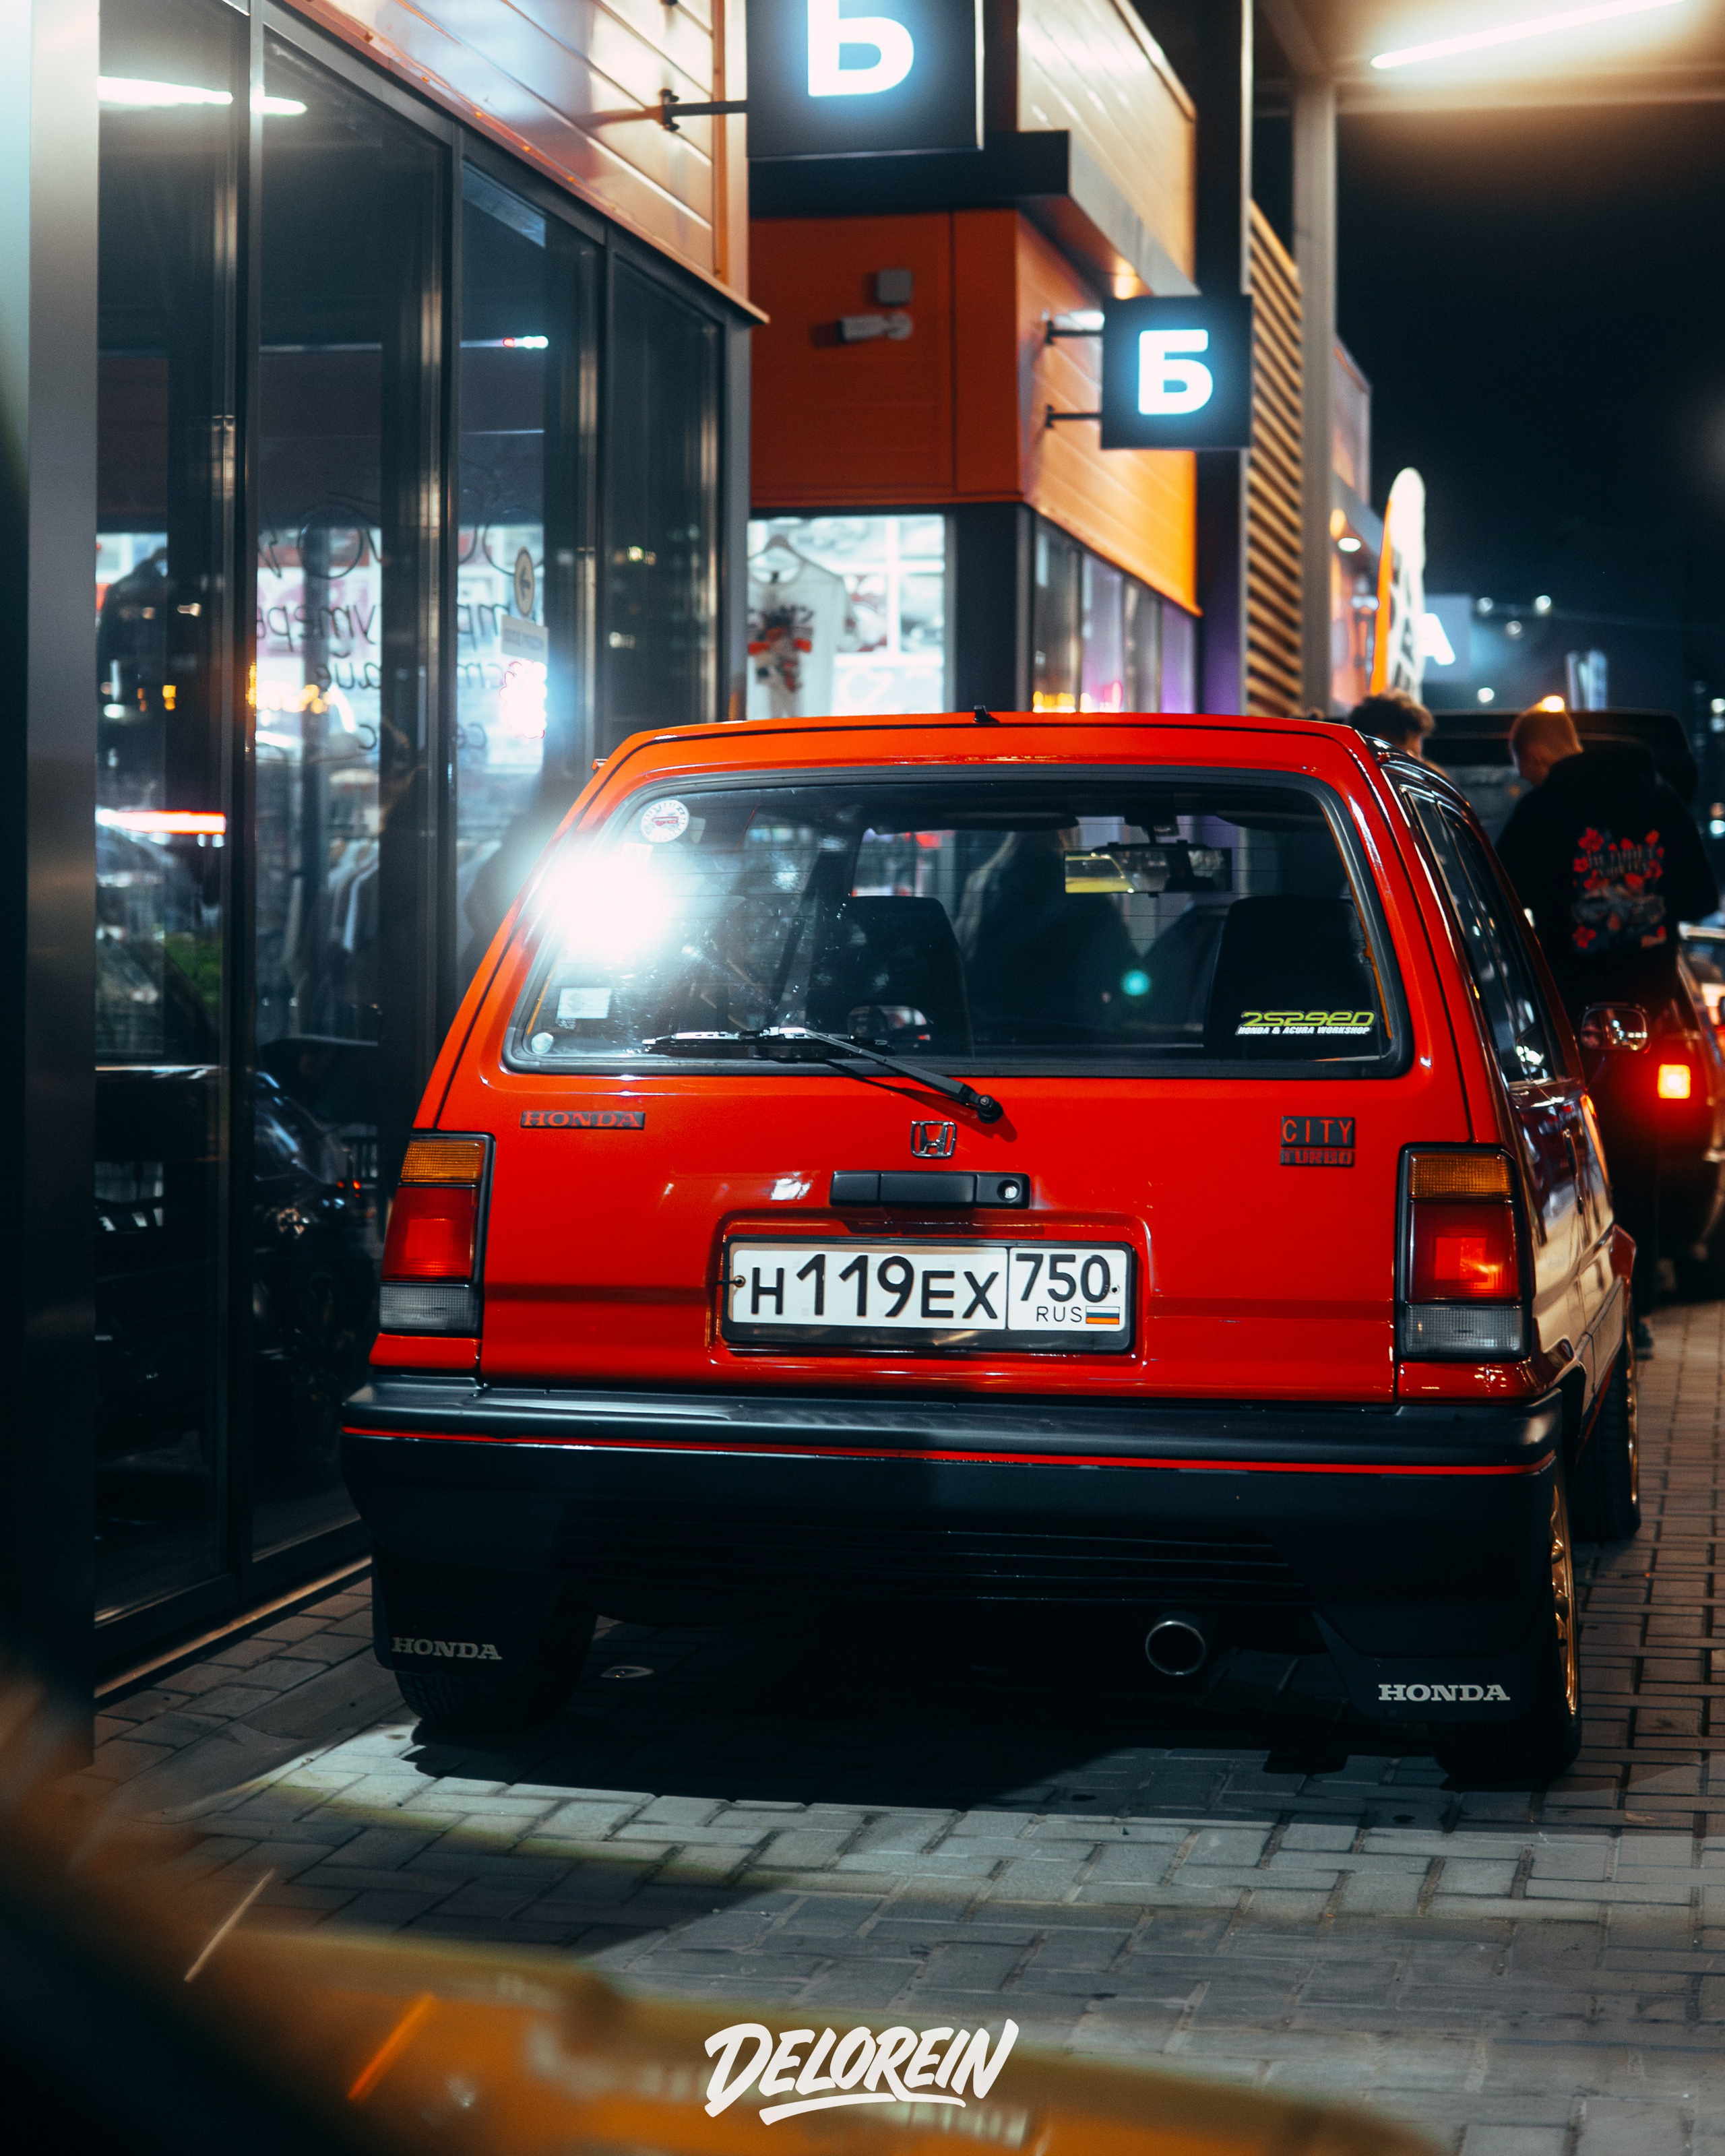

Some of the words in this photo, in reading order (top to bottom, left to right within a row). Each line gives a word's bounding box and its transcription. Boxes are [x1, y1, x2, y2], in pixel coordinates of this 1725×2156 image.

[1139, 329, 1213, 415] Б
[1237, 1025, 1269, 1034] HONDA
[1272, 1026, 1281, 1034] &
[1282, 1026, 1315, 1034] ACURA
[1317, 1026, 1370, 1035] WORKSHOP
[523, 1112, 642, 1128] HONDA
[1282, 1119, 1352, 1144] CITY
[1015, 1253, 1110, 1303] 750
[1036, 1306, 1083, 1323] RUS
[391, 1637, 503, 1660] HONDA
[1378, 1684, 1511, 1702] HONDA
